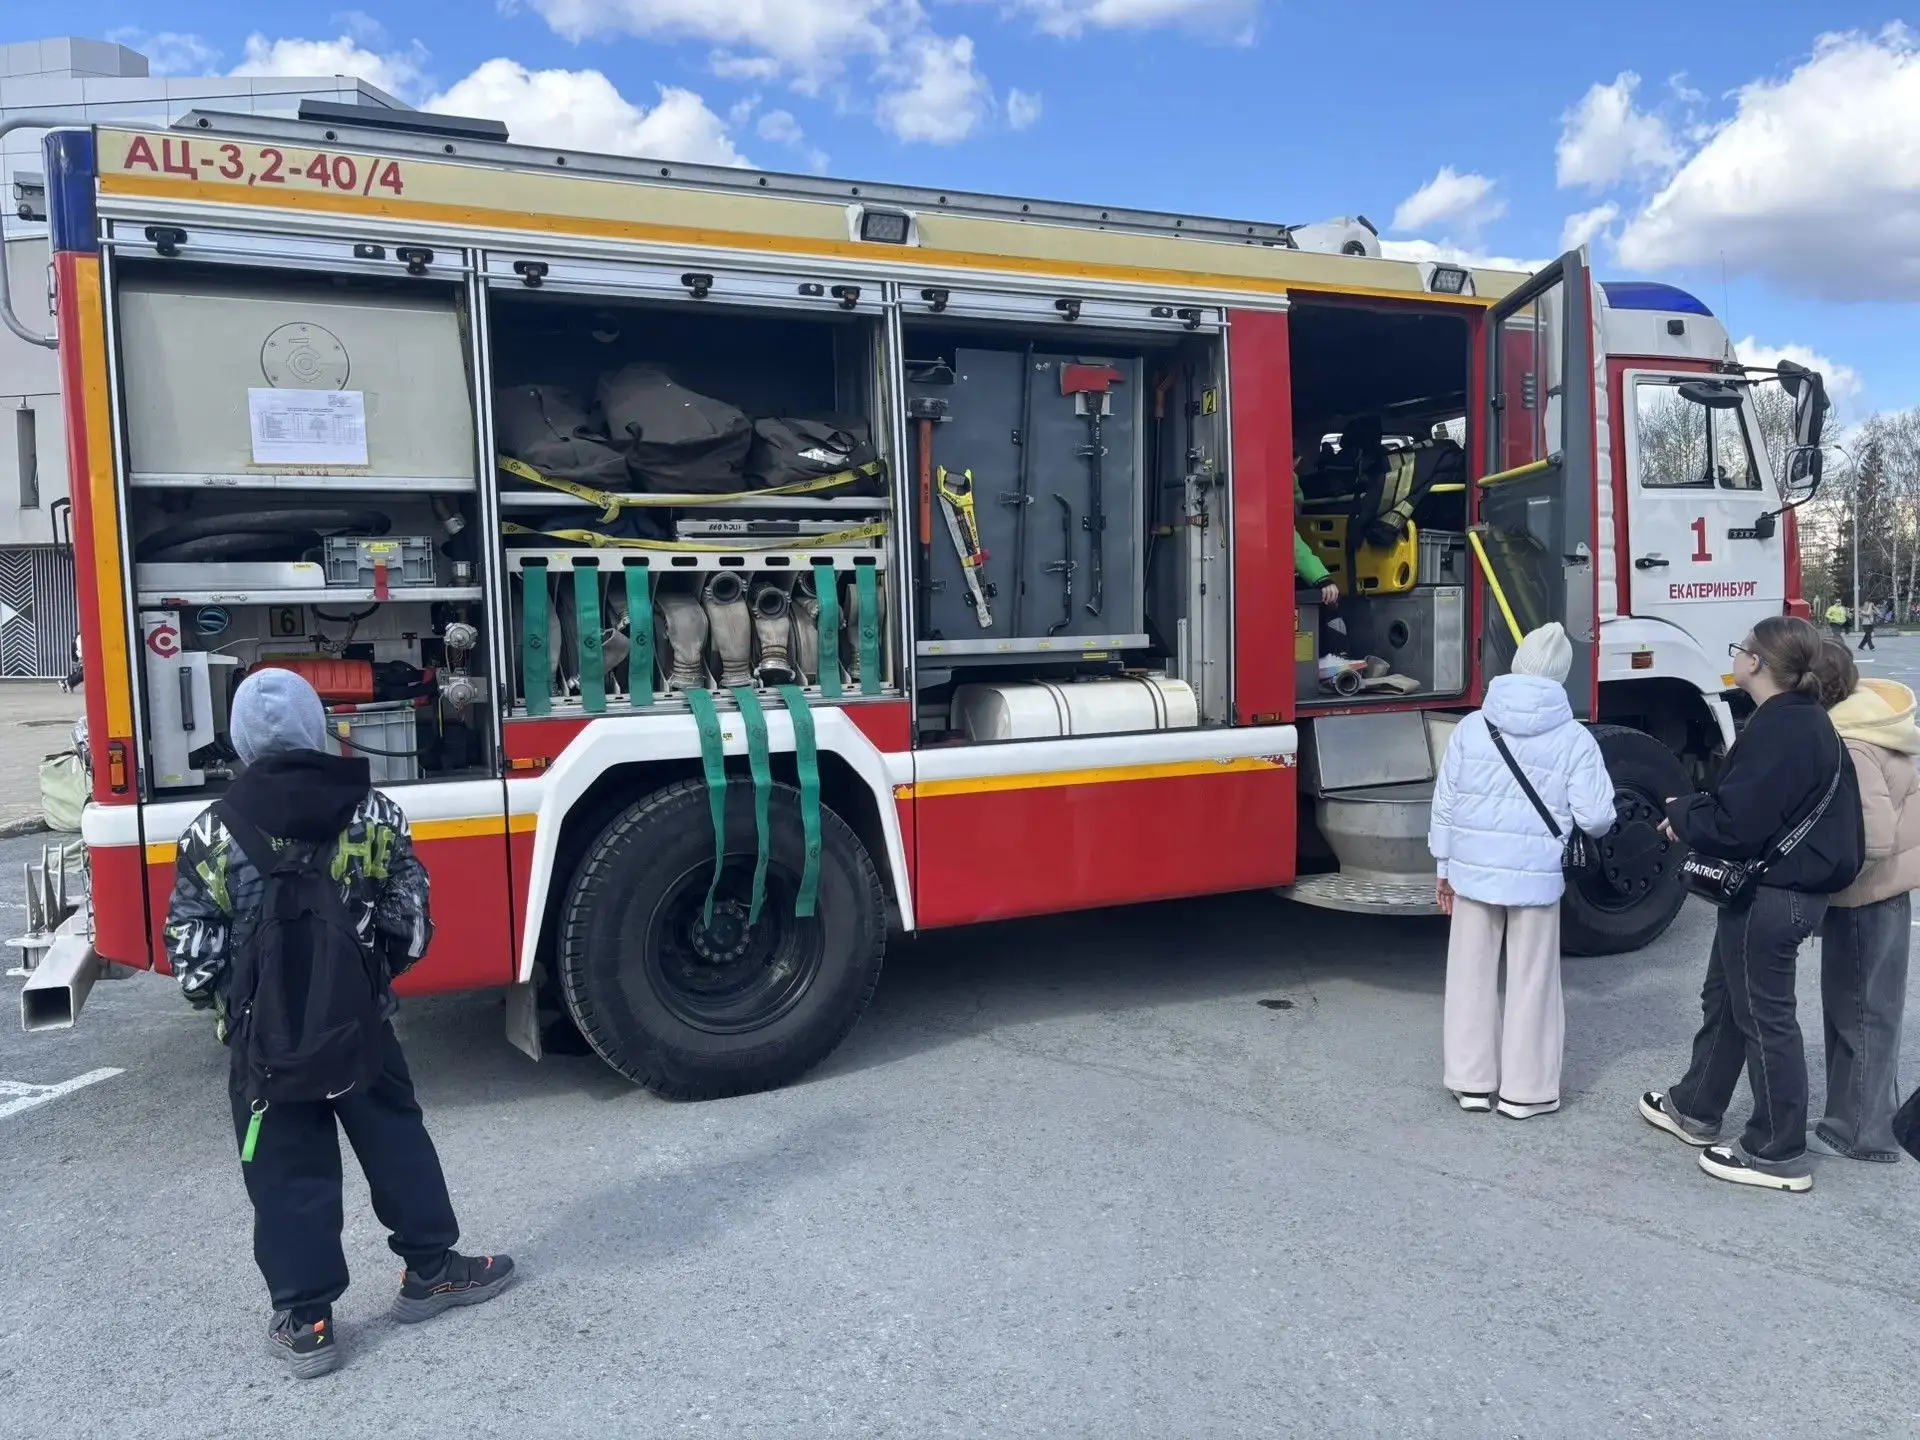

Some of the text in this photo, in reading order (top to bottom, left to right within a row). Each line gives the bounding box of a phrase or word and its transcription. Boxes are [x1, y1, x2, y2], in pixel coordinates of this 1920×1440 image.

[124, 136, 404, 196] АЦ-3,2-40/4
[1691, 517, 1712, 562] 1
[1669, 581, 1758, 599] ЕКАТЕРИНБУРГ
[280, 609, 296, 634] 6
